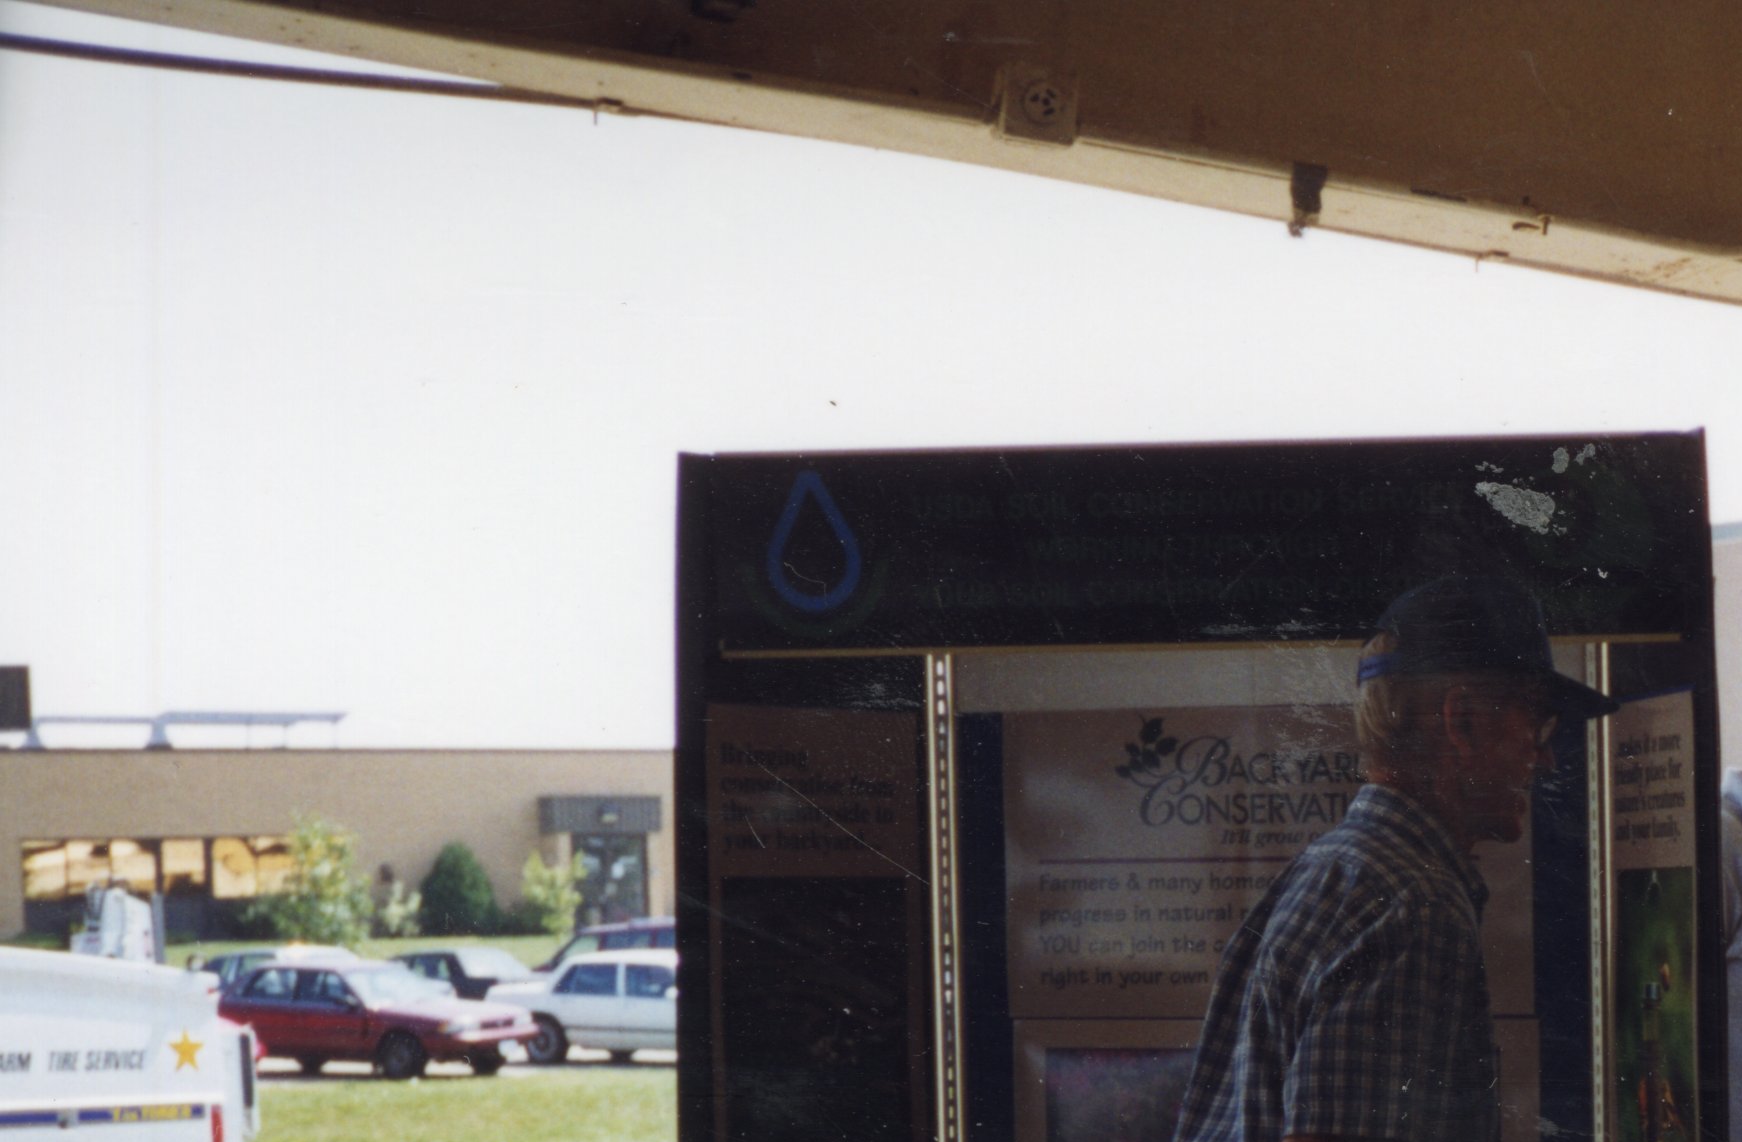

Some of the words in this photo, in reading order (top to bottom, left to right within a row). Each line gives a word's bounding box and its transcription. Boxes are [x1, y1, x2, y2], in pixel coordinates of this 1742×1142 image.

[1658, 735, 1681, 752] more
[1668, 757, 1682, 778] for
[1140, 776, 1350, 826] CONSERVATI
[1255, 831, 1305, 850] grow
[1039, 873, 1121, 892] Farmers
[1125, 872, 1141, 891] &
[1147, 874, 1203, 894] many
[1039, 906, 1128, 927] progress
[1133, 905, 1152, 922] in
[1158, 905, 1233, 922] natural
[1040, 935, 1082, 955] YOU
[1088, 938, 1122, 954] can
[1129, 935, 1166, 958] join
[1172, 935, 1208, 955] the
[1040, 968, 1090, 990] right
[1095, 968, 1113, 985] in
[1118, 970, 1164, 990] your
[1169, 970, 1209, 985] own
[48, 1052, 79, 1071] TIRE
[85, 1050, 145, 1071] SERVICE
